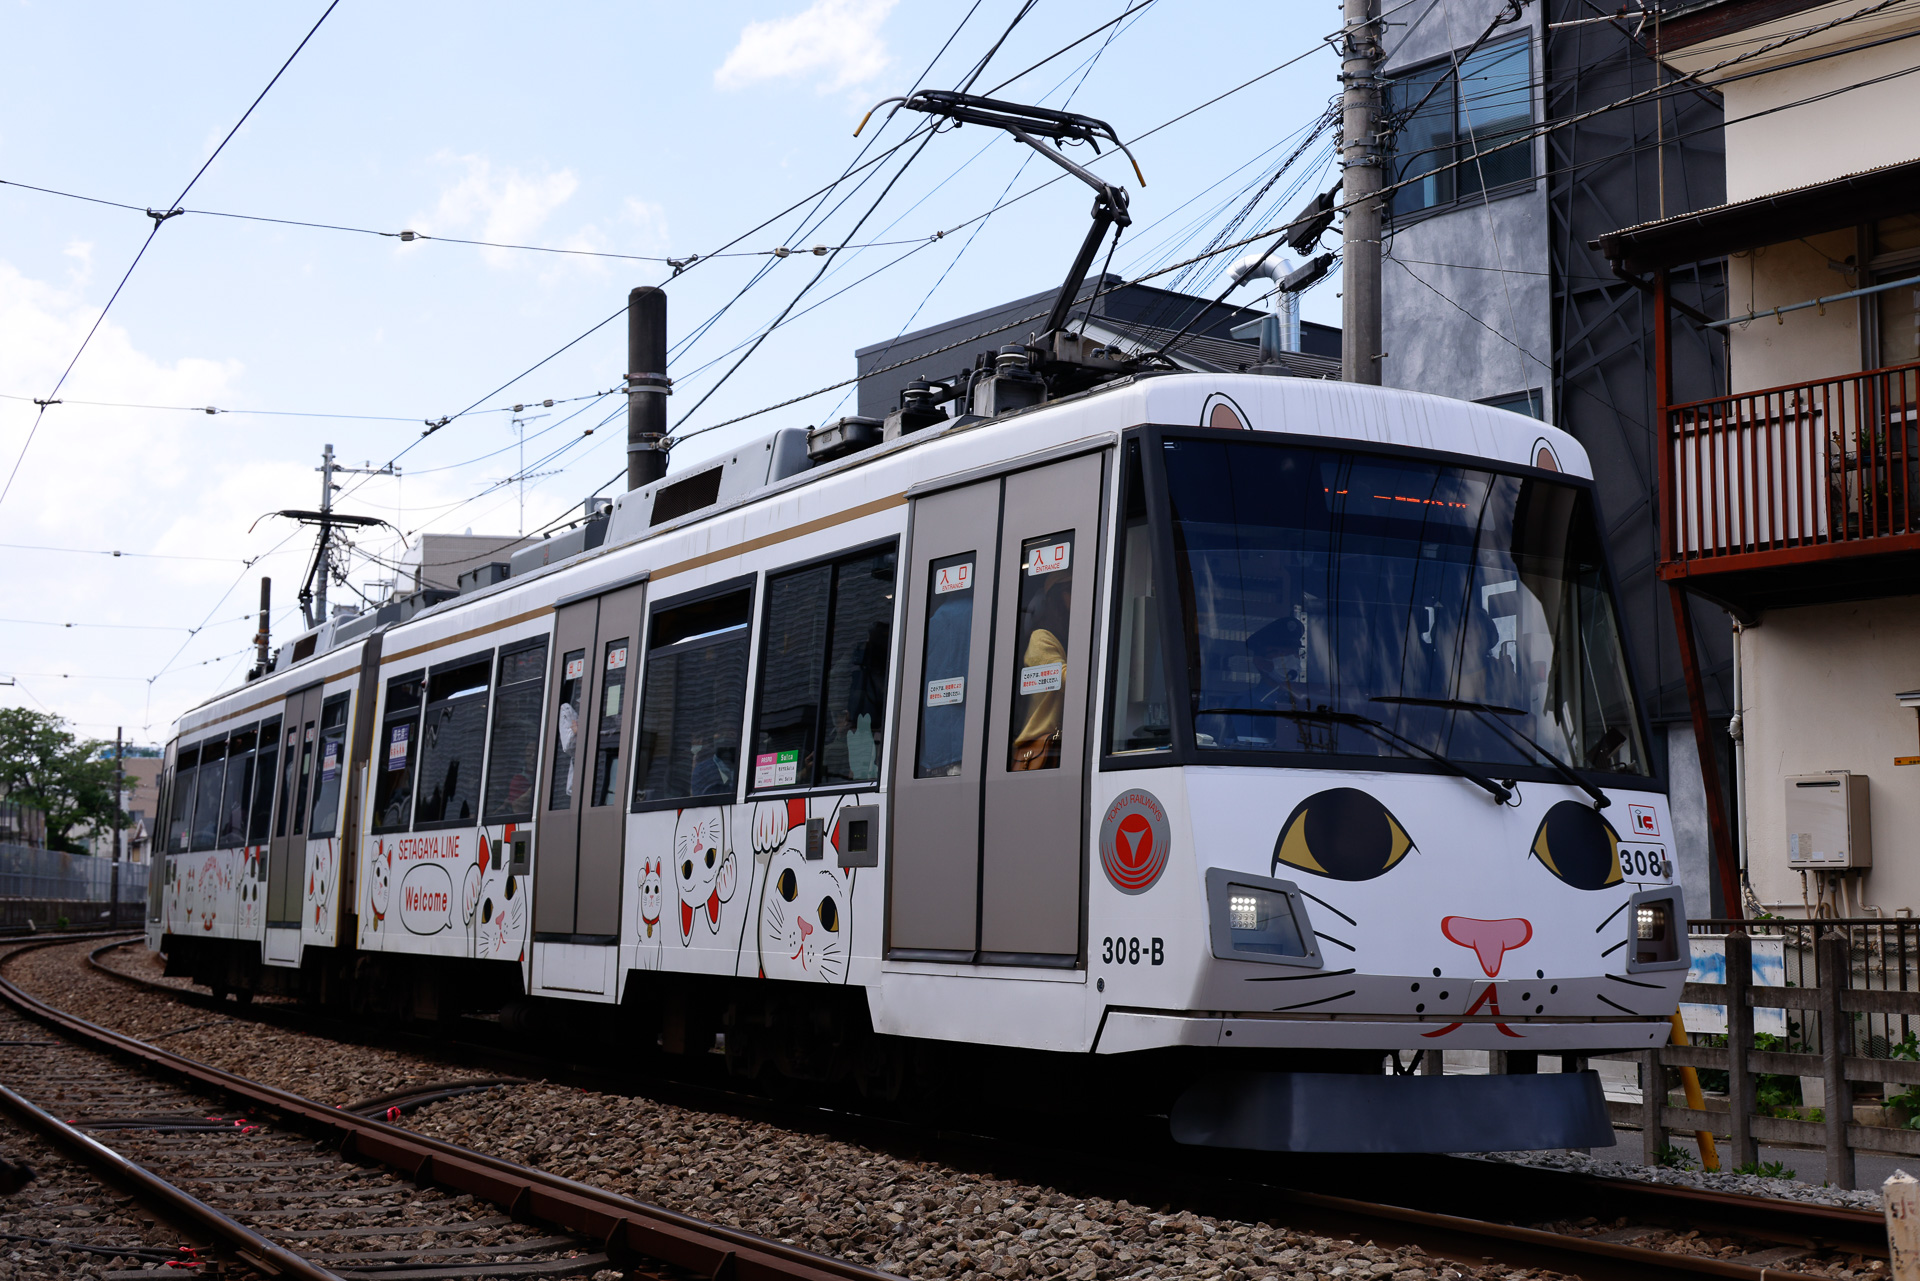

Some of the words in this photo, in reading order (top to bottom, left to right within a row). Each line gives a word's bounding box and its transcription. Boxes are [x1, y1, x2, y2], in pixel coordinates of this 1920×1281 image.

[1034, 545, 1064, 566] 入口
[1036, 562, 1060, 573] ENTRANCE
[940, 566, 967, 585] 入口
[780, 754, 793, 762] Suica
[1107, 796, 1129, 823] TOKYU
[1130, 794, 1163, 822] RAILWAYS
[398, 837, 439, 861] SETAGAYA
[441, 835, 460, 858] LINE
[1620, 849, 1662, 877] 308
[405, 886, 448, 912] Welcome
[1102, 936, 1165, 966] 308-B
